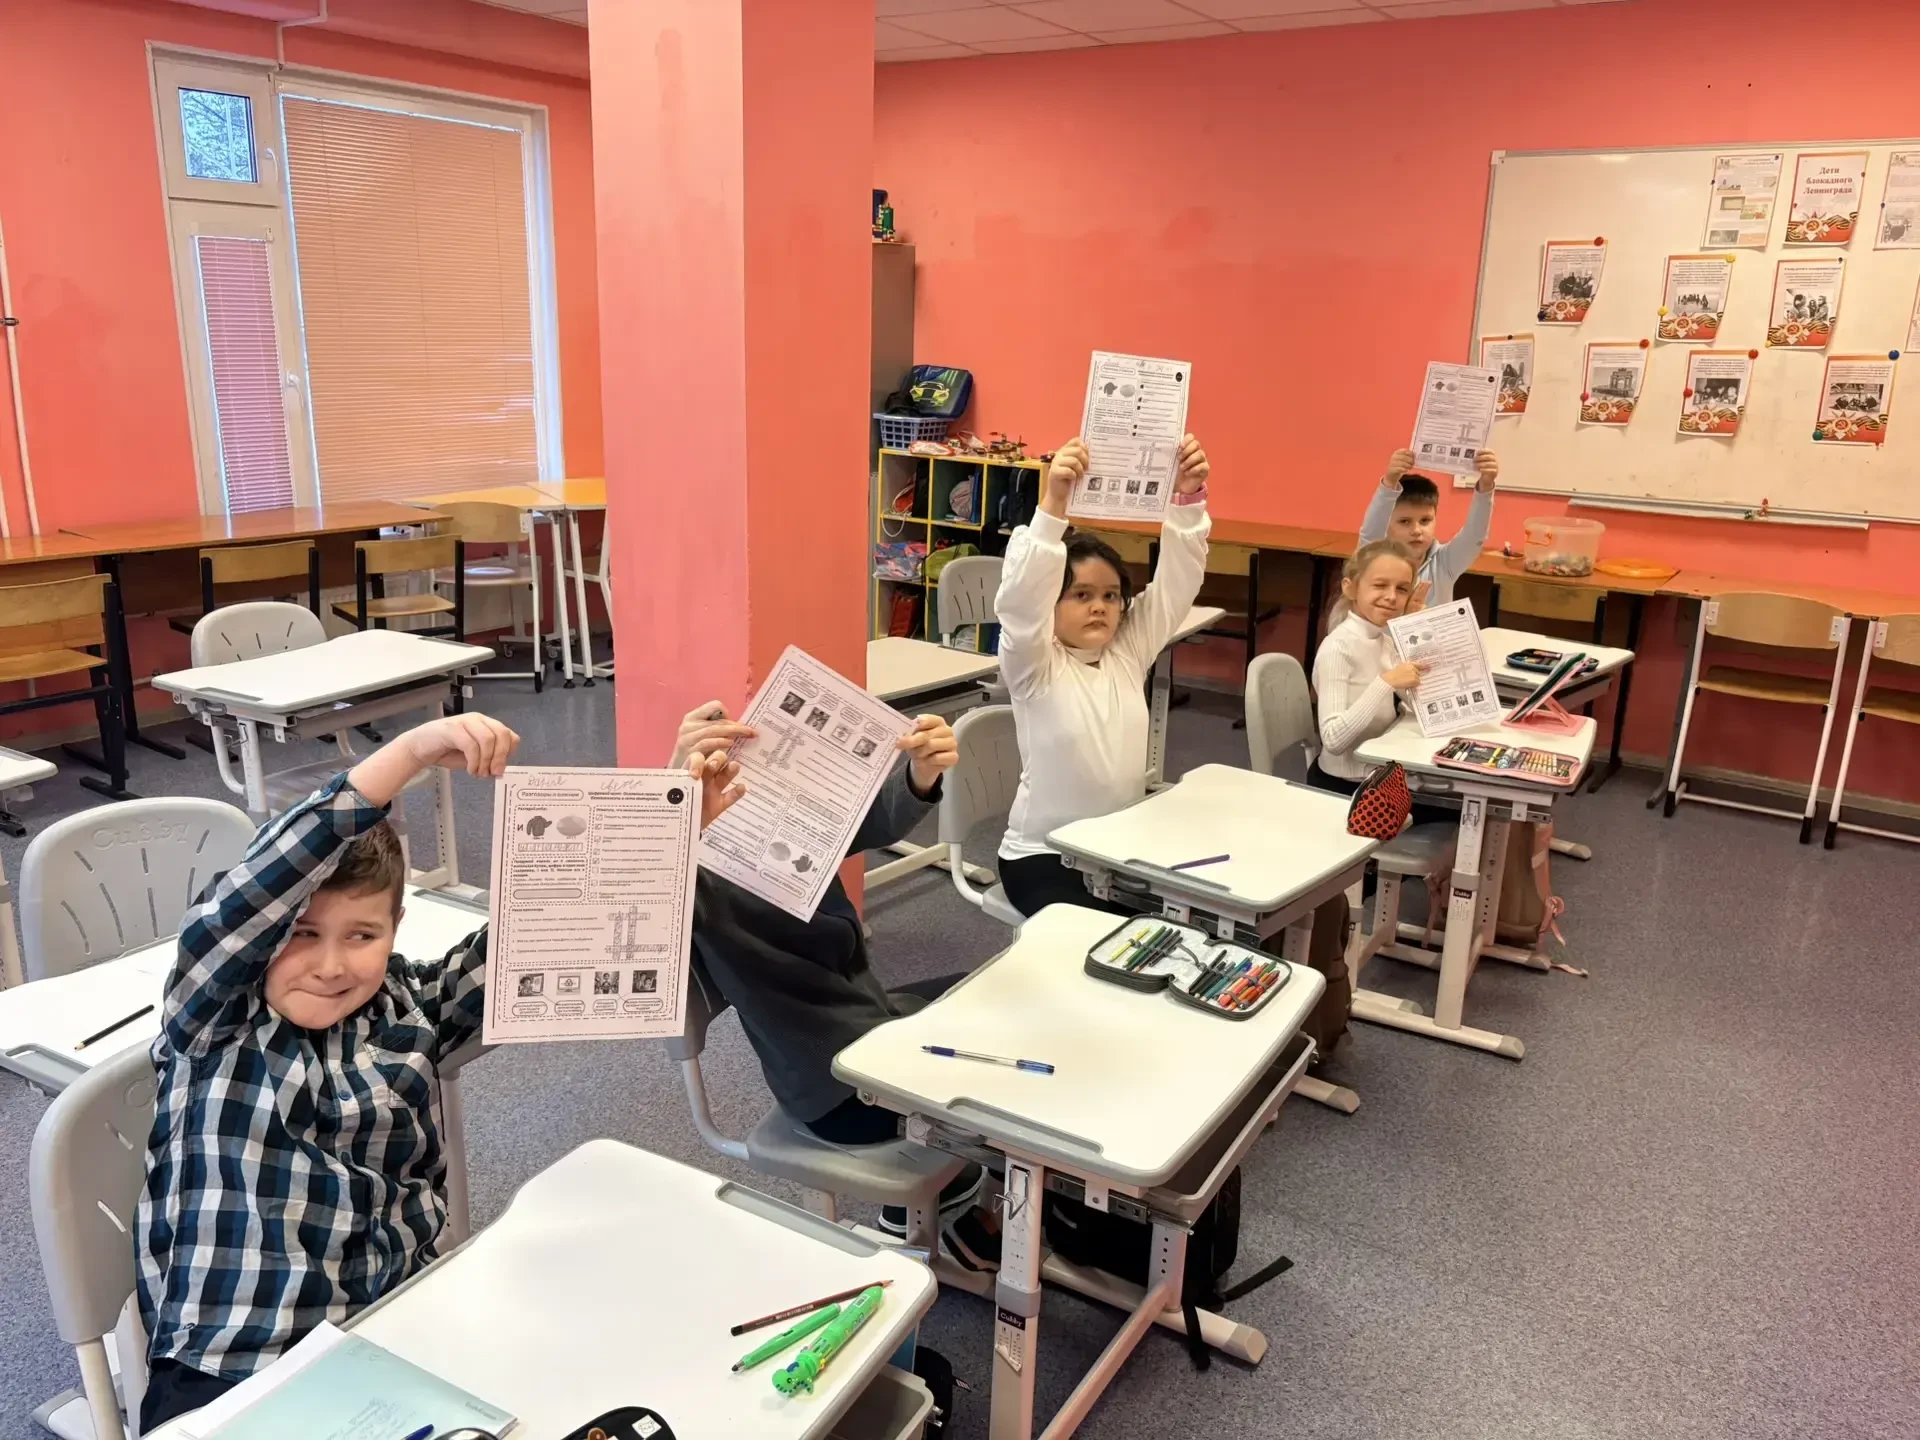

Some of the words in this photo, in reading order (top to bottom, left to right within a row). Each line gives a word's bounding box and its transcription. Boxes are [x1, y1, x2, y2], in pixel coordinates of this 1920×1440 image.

[1819, 167, 1840, 175] Дети
[1803, 187, 1852, 195] Ленинграда
[517, 823, 524, 832] И
[91, 817, 190, 851] Cubby
[1000, 1312, 1023, 1328] Cubby
